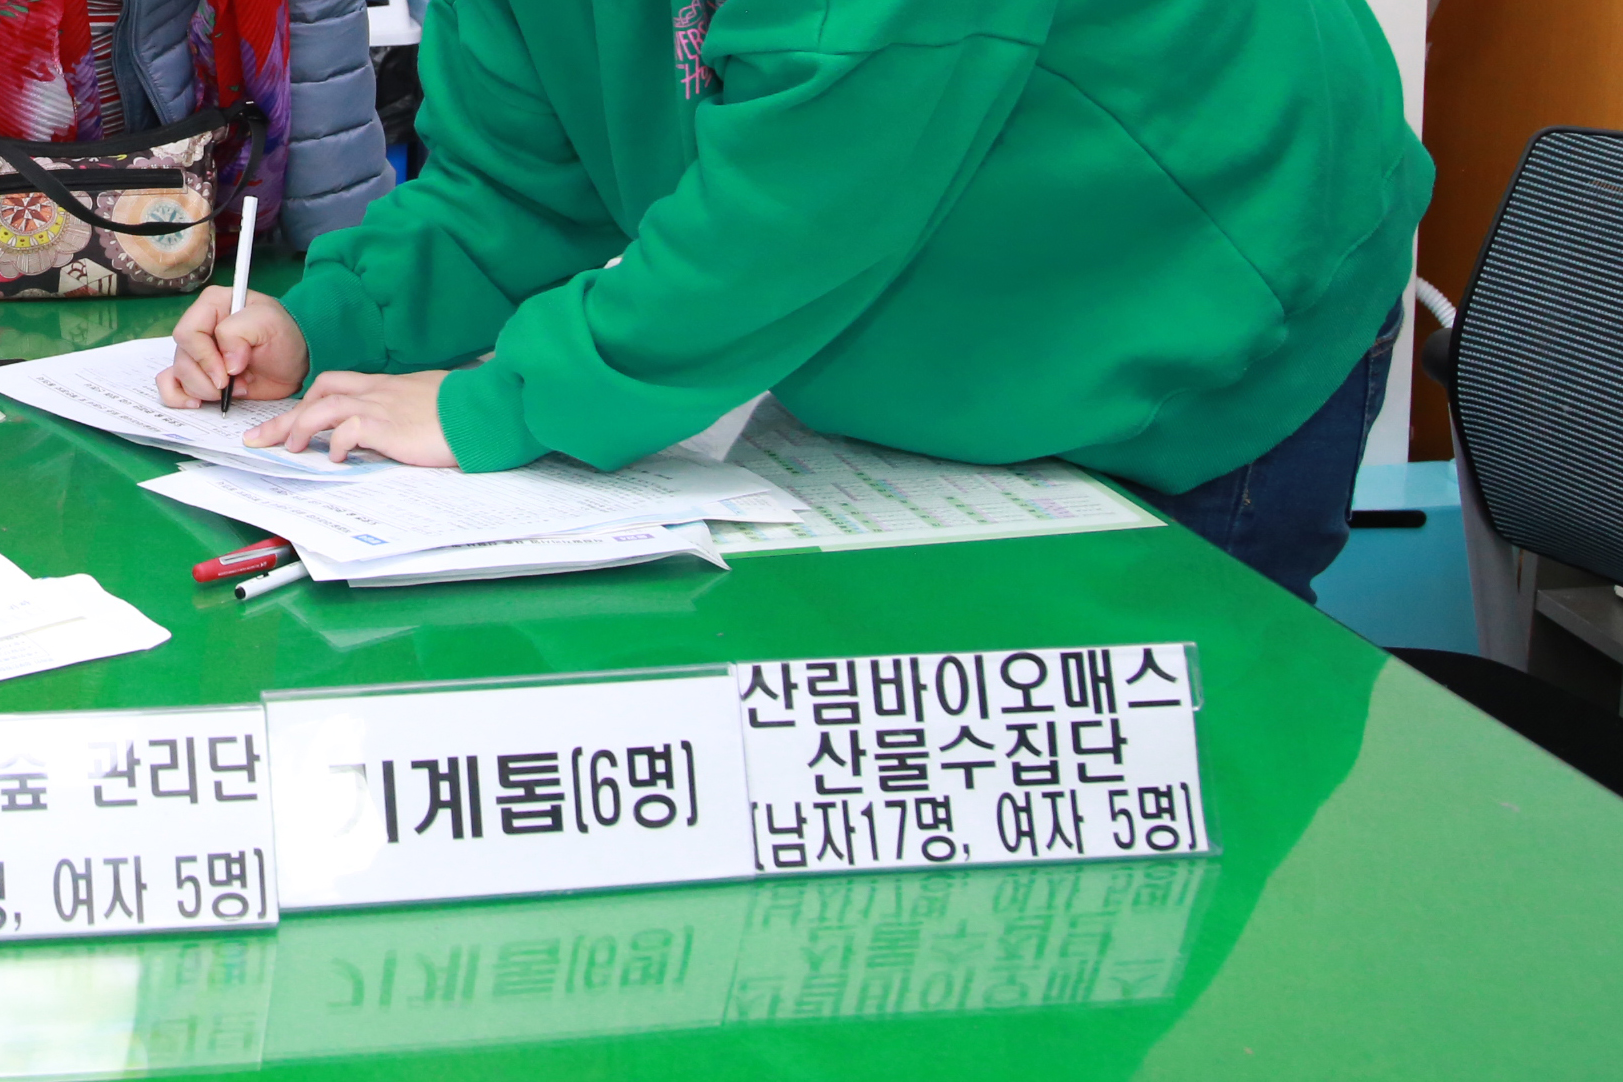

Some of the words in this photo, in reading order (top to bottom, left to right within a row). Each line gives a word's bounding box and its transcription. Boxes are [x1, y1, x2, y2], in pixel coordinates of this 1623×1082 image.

[740, 647, 1181, 729] 산림바이오매스
[89, 734, 260, 808] 관리단
[328, 740, 699, 843] 기계톱(6명)
[807, 717, 1128, 796] 산물수집단
[751, 794, 971, 872] (남자17명,
[996, 788, 1084, 857] 여자
[1109, 782, 1197, 852] 5명)
[53, 854, 148, 926] 여자
[175, 847, 268, 921] 5명)
